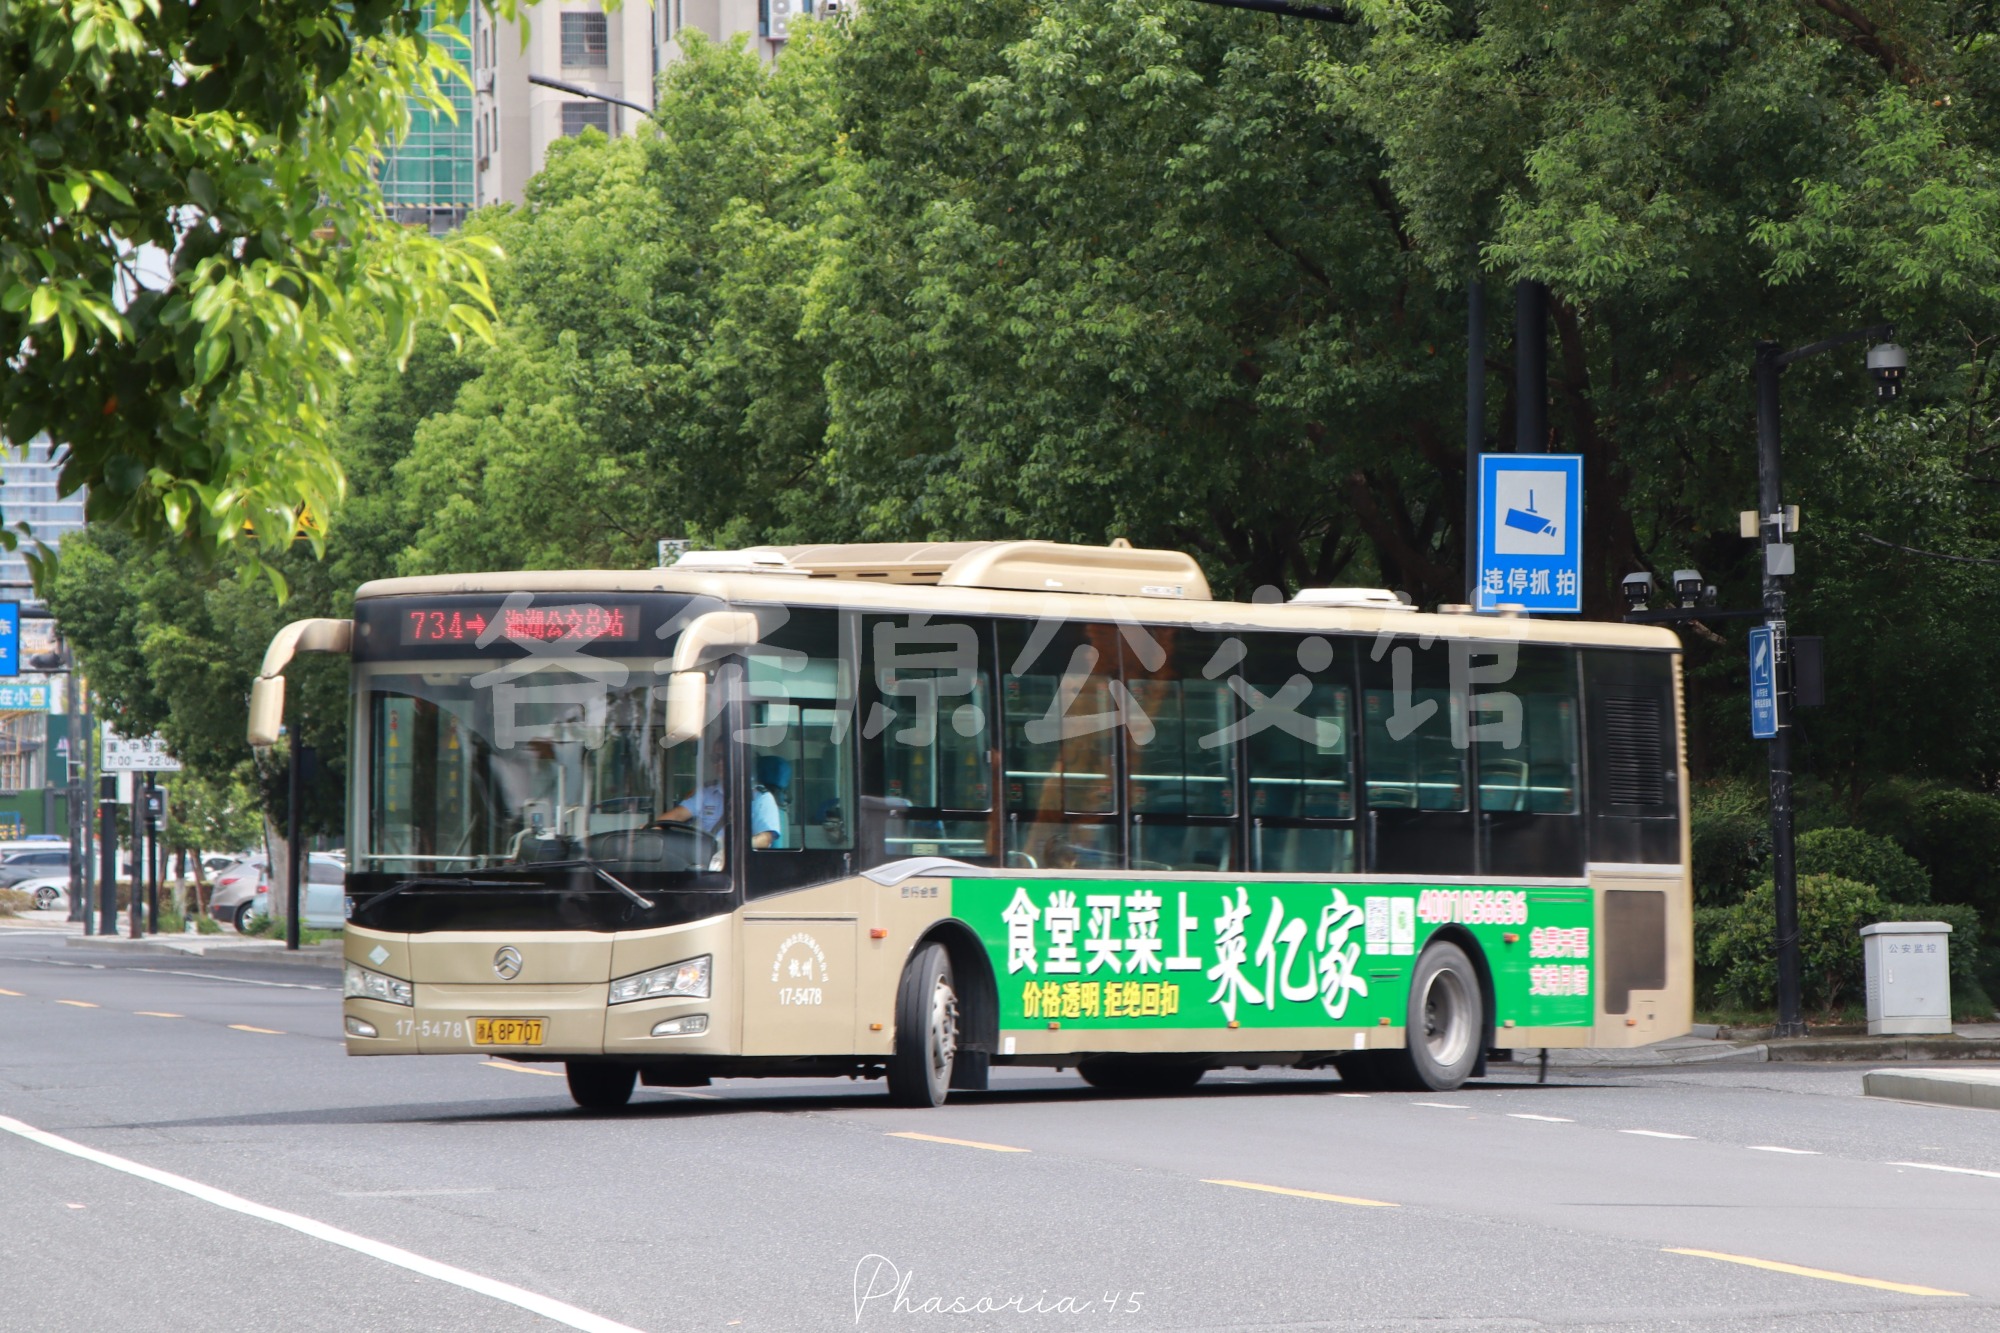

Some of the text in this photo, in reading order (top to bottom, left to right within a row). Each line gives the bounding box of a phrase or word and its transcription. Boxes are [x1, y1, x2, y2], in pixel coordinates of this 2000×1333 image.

[1483, 567, 1576, 596] 违停抓拍
[411, 608, 624, 639] 734 湘湖公交总站
[1417, 889, 1529, 925] 4001056636
[1002, 887, 1202, 976] 食堂买菜上
[1529, 926, 1590, 958] 免费开票
[1207, 886, 1368, 1021] 菜亿家
[1888, 943, 1937, 954] 公安监控
[1529, 964, 1589, 996] 支持月结
[779, 987, 822, 1006] 17-5478
[1022, 980, 1179, 1019] 价格透明 拒绝回扣
[395, 1019, 463, 1039] 17-5478
